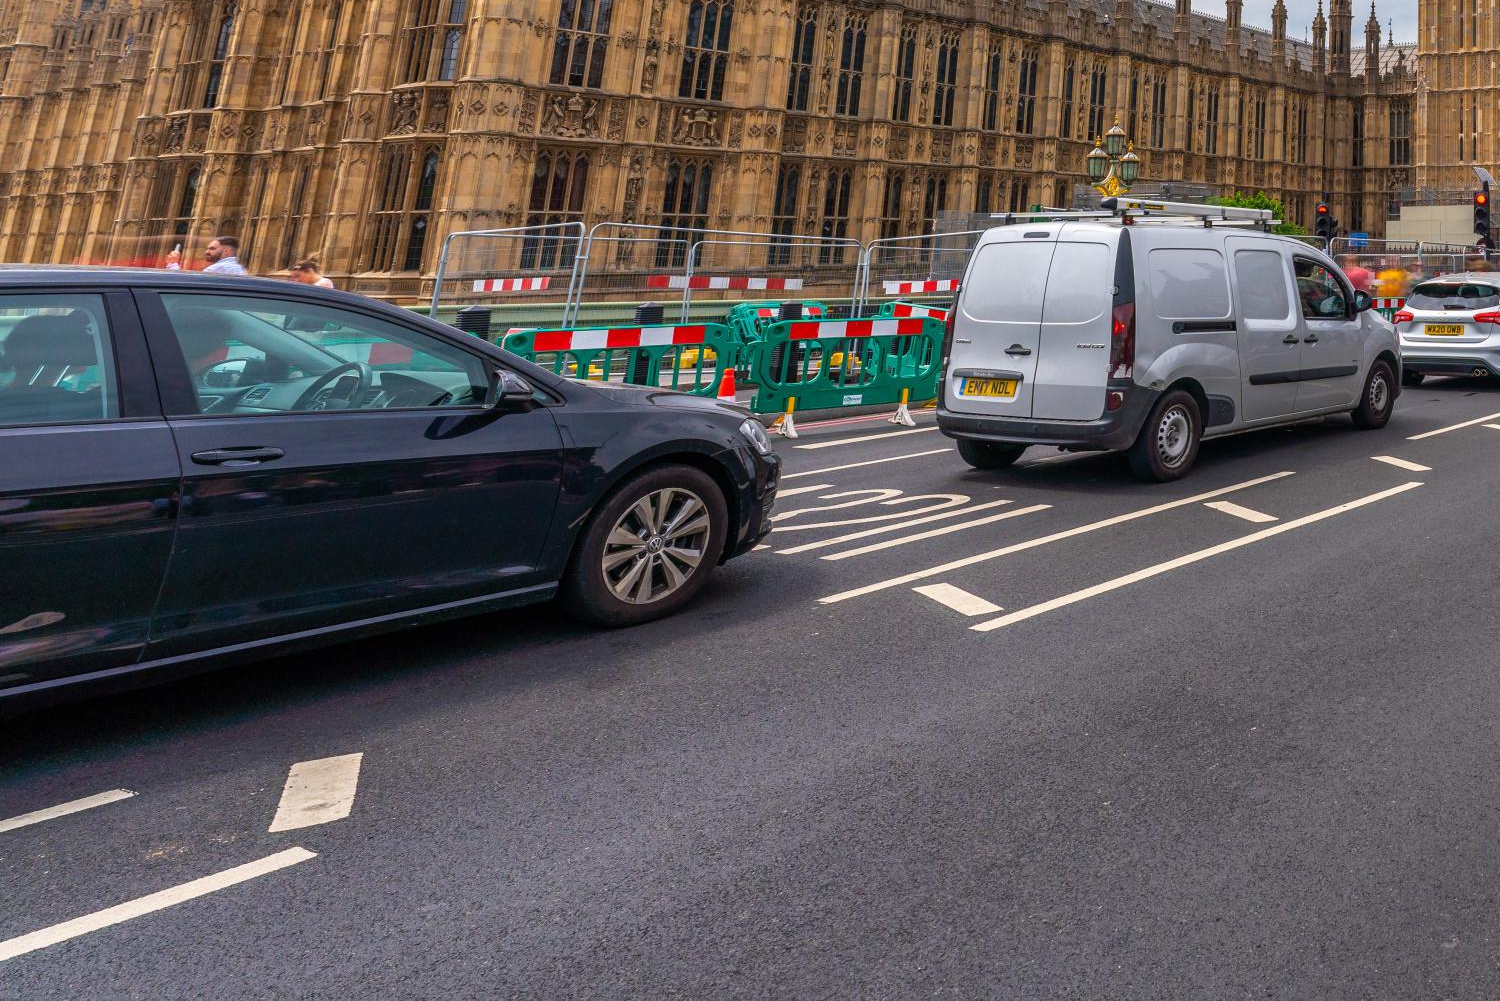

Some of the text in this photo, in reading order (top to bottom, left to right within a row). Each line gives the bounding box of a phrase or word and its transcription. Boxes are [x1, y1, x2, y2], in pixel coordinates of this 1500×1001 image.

[1447, 325, 1461, 333] OWB
[967, 381, 1010, 395] EN17 NDL
